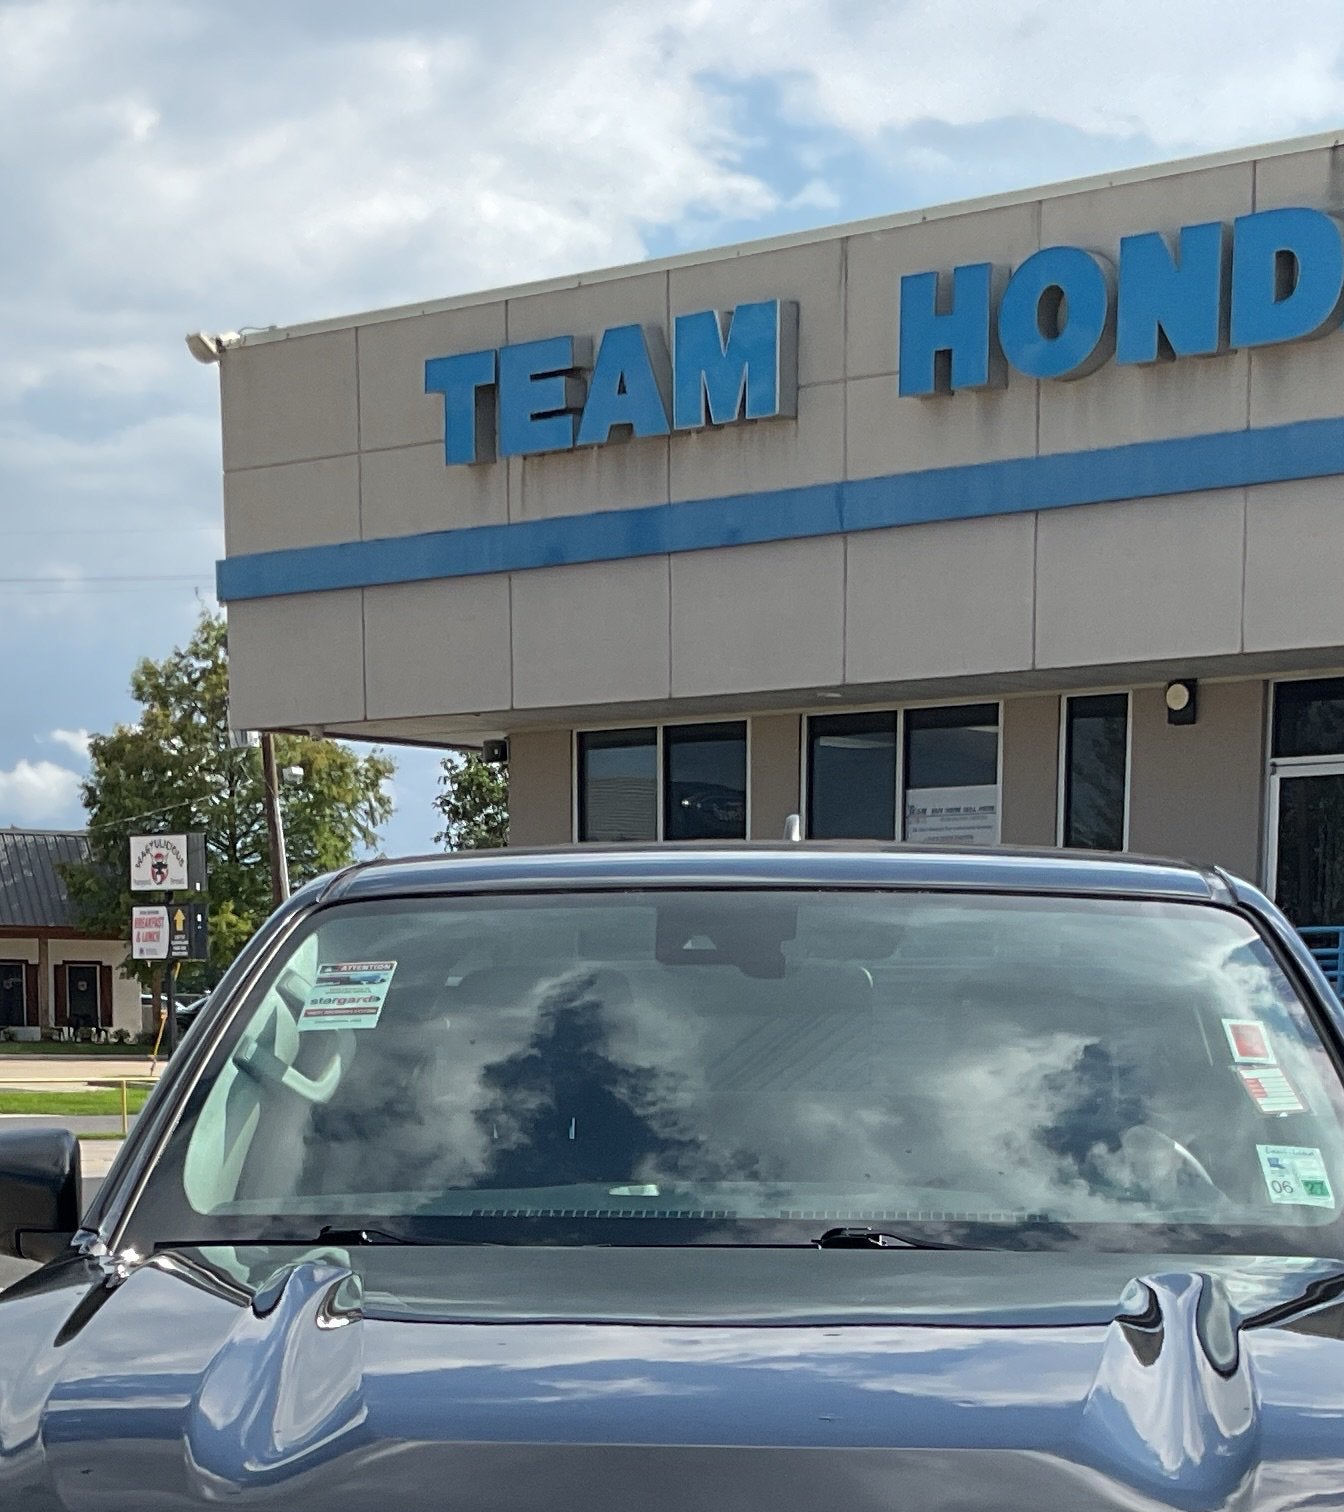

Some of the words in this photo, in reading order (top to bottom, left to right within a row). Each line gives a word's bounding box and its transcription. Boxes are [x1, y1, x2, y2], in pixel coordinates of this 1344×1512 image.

[425, 299, 782, 466] TEAM
[134, 916, 165, 929] BREAKFAST
[340, 964, 391, 972] ATTENTION
[1271, 1180, 1294, 1194] 06
